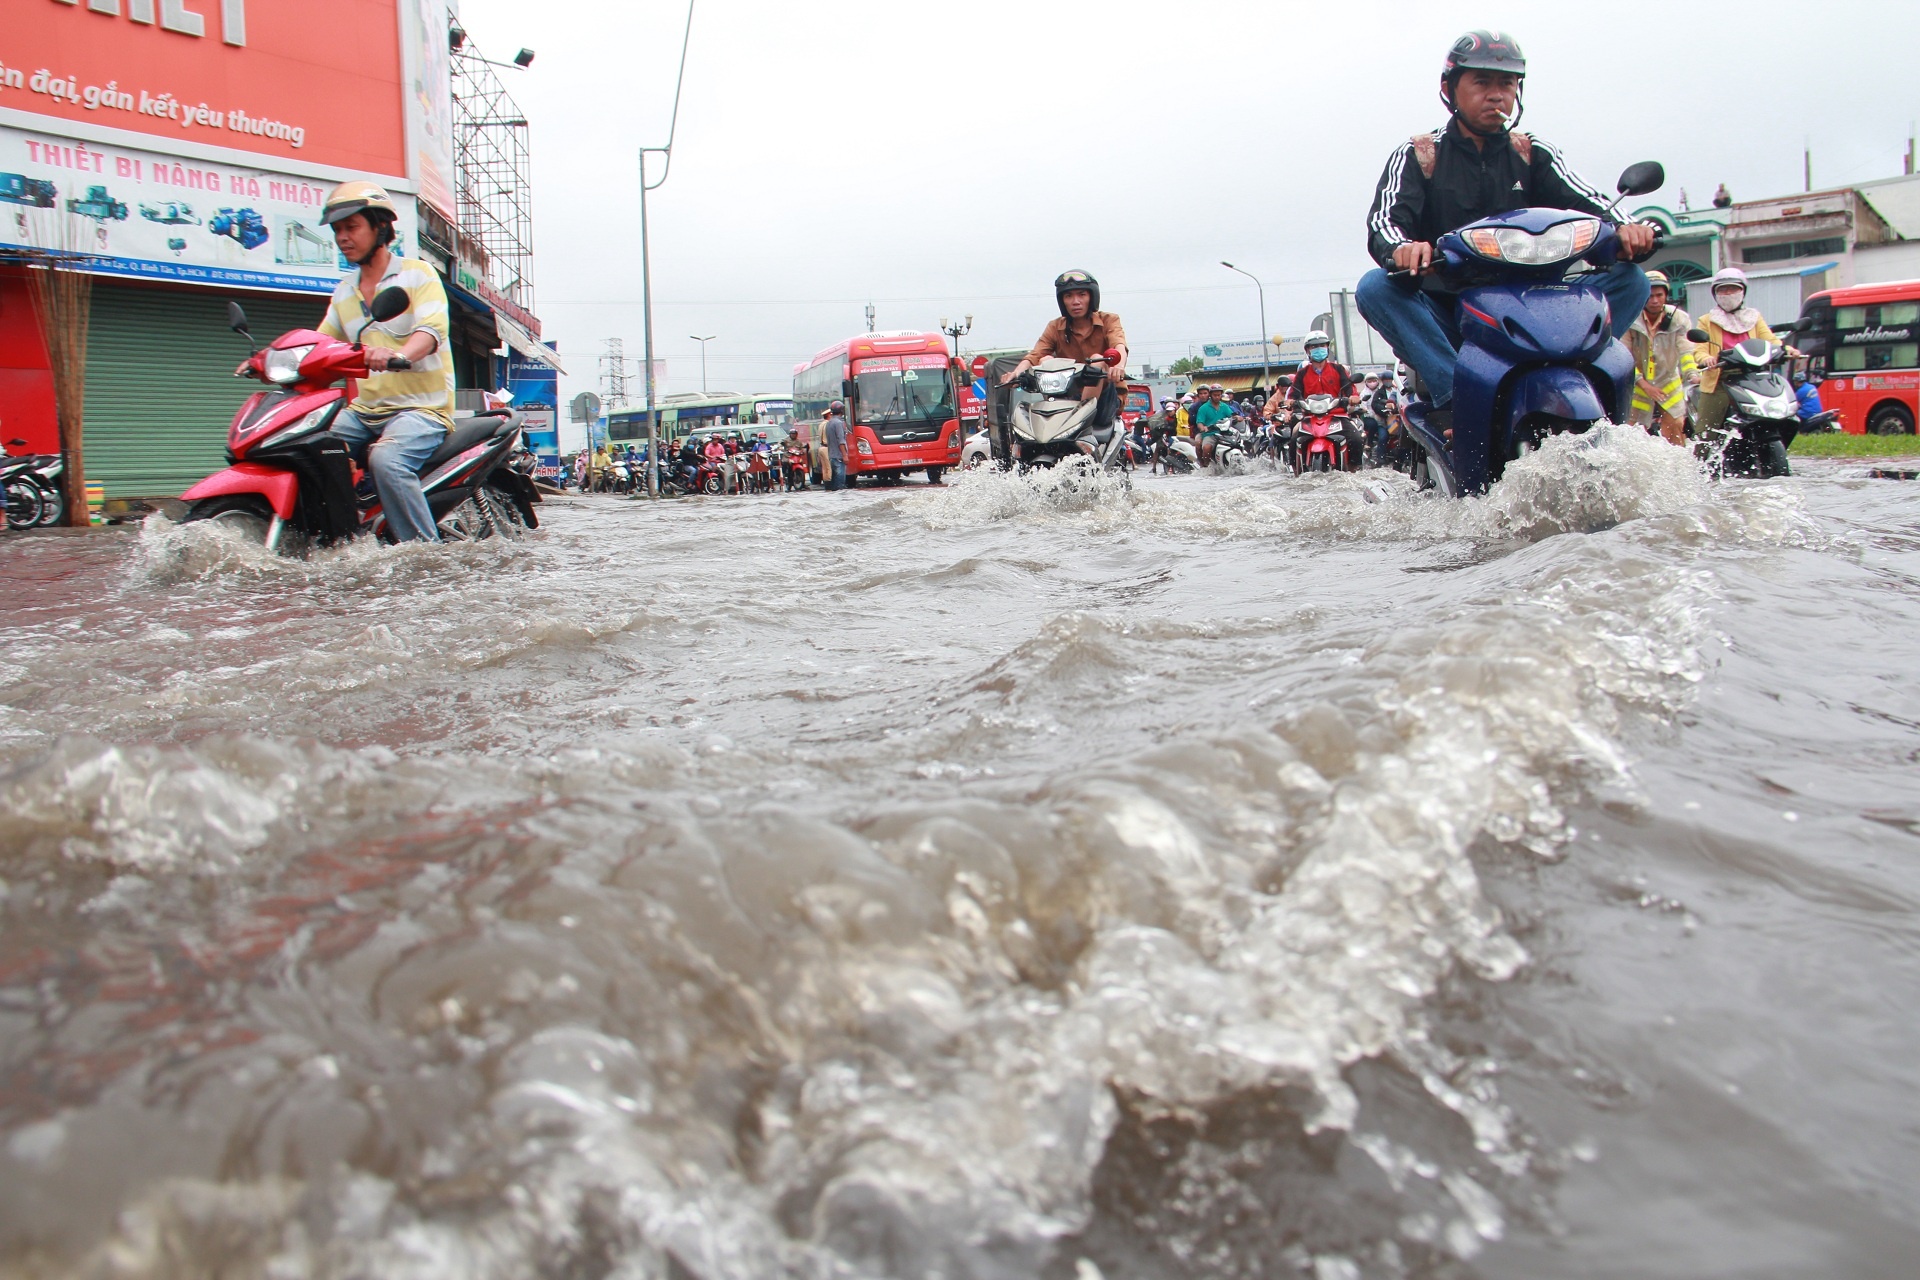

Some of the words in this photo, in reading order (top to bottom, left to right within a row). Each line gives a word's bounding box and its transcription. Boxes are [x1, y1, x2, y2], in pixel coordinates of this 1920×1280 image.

[138, 90, 179, 120] kết
[181, 103, 223, 128] yêu
[228, 110, 305, 147] thương
[25, 139, 104, 174] THIẾT
[115, 156, 142, 184] BỊ
[154, 161, 221, 192] NÂNG
[230, 175, 261, 204] HẠ
[269, 181, 324, 207] NHẬT
